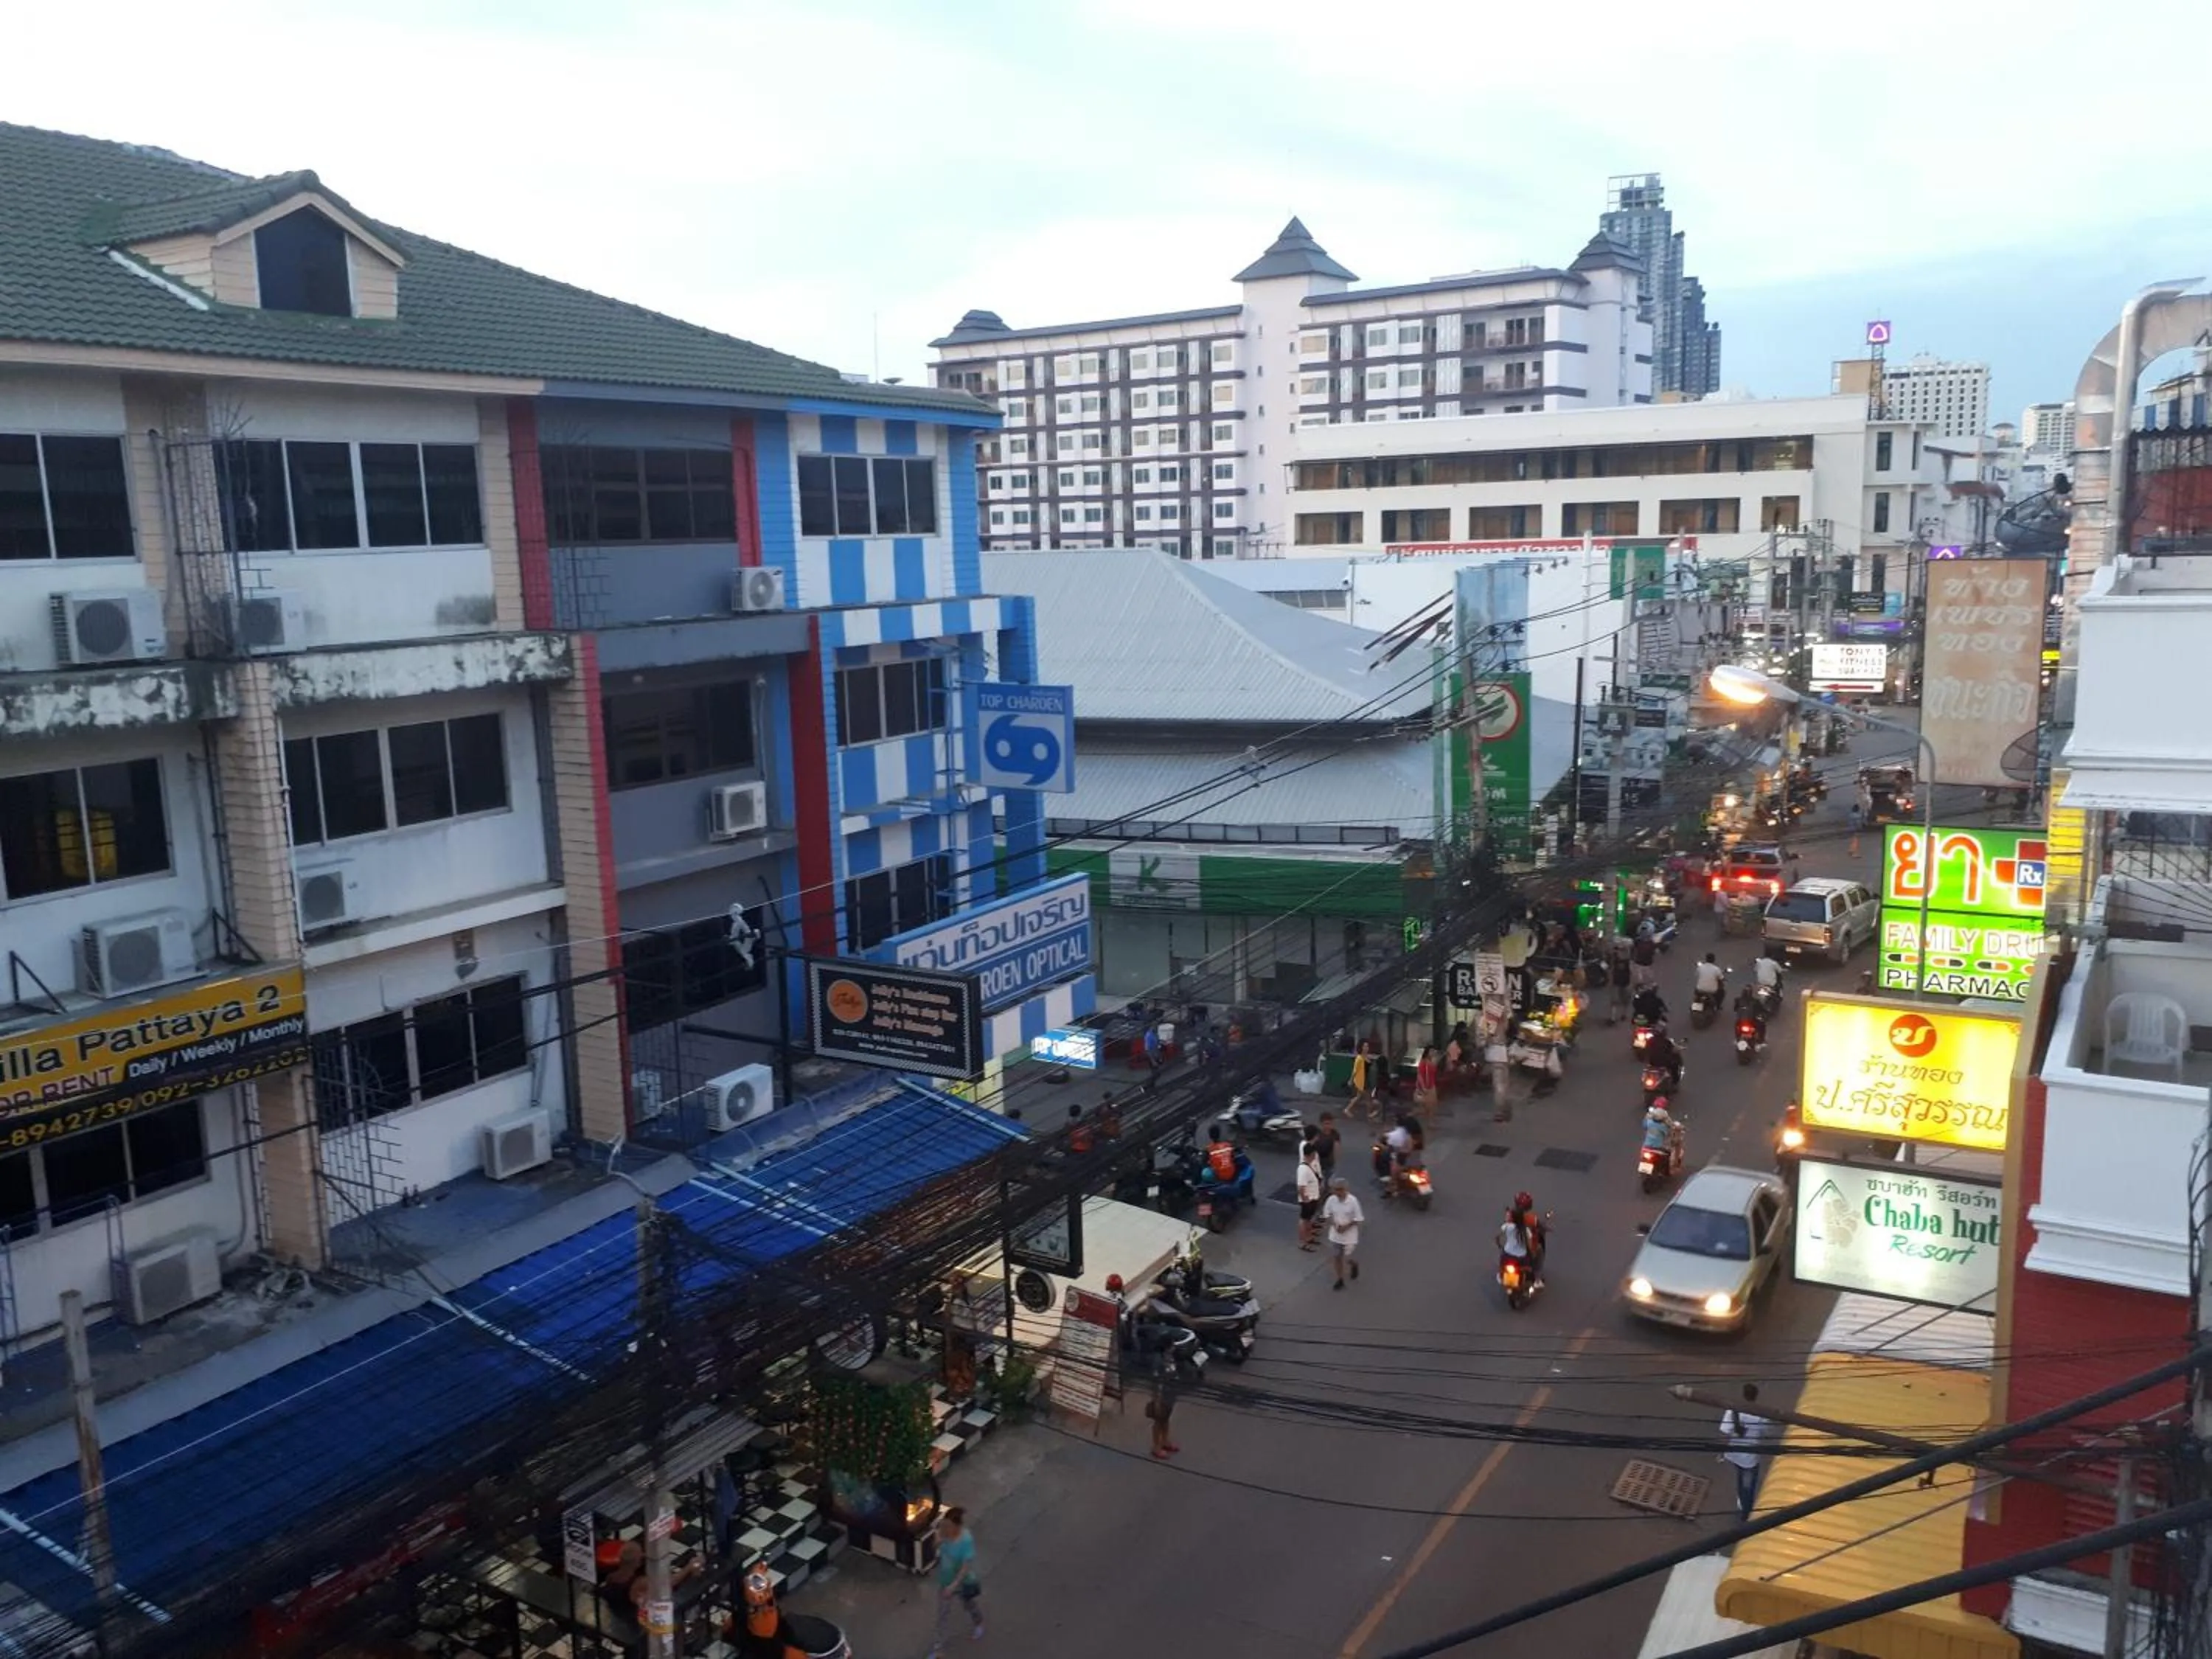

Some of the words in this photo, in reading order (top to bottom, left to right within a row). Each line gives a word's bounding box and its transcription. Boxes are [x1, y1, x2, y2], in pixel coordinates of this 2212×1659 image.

[981, 694, 1003, 708] TOP
[1006, 695, 1063, 712] CHAROEN
[1893, 832, 1980, 903] ยา
[2019, 863, 2042, 884] Rx
[1026, 933, 1086, 980] OPTICAL
[1886, 923, 1978, 952] FAMILY
[77, 1000, 246, 1061] Pattaya
[257, 984, 279, 1013] 2
[128, 1057, 167, 1078] Daily
[181, 1036, 237, 1062] Weekly
[249, 1017, 305, 1044] Monthly
[42, 1066, 114, 1105] RENT
[1858, 1054, 1964, 1085] ร้านทอง
[1864, 1194, 1943, 1235] Chaba
[1952, 1208, 2001, 1246] hut
[1888, 1234, 1978, 1265] Resort
